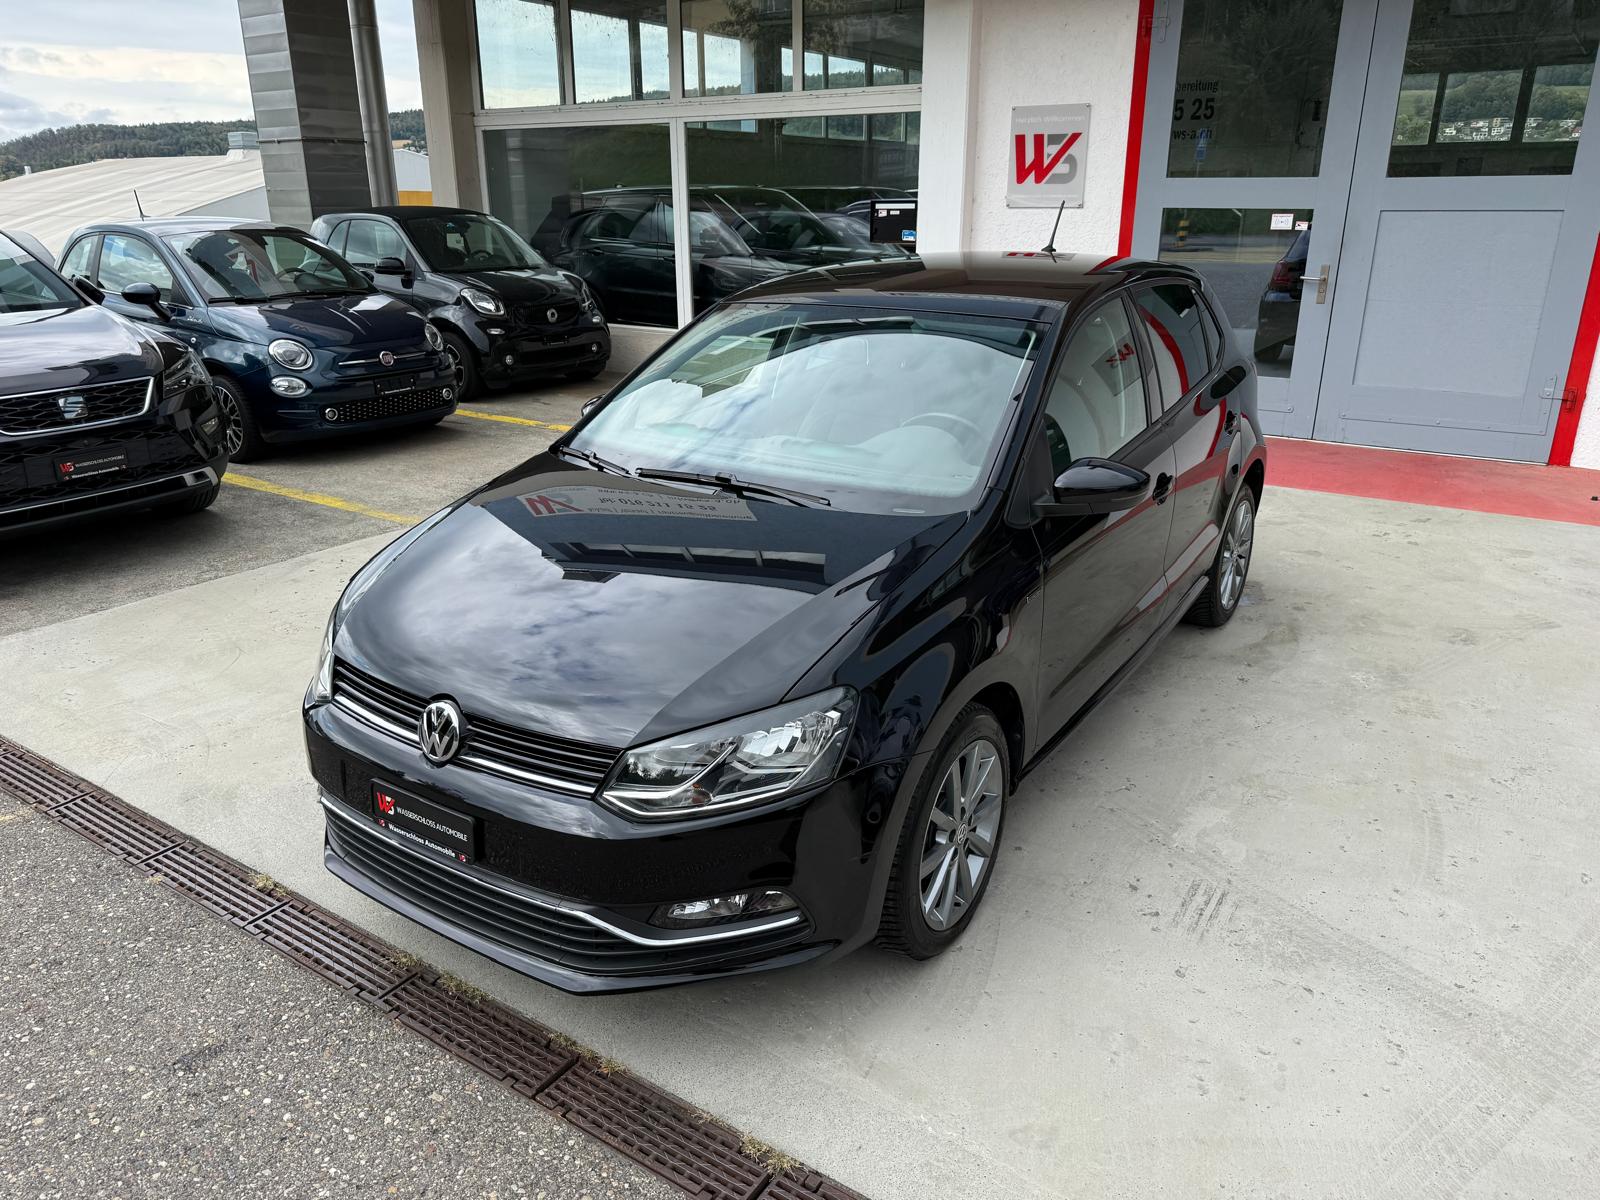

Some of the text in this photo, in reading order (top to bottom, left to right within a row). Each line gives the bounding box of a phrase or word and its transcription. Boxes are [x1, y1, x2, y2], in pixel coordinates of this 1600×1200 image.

[1191, 97, 1215, 120] 25
[388, 823, 456, 858] Wasserschloss Automobile
[396, 806, 436, 829] WASSERSCHLOSS
[436, 824, 468, 842] AUTOMOBILE
